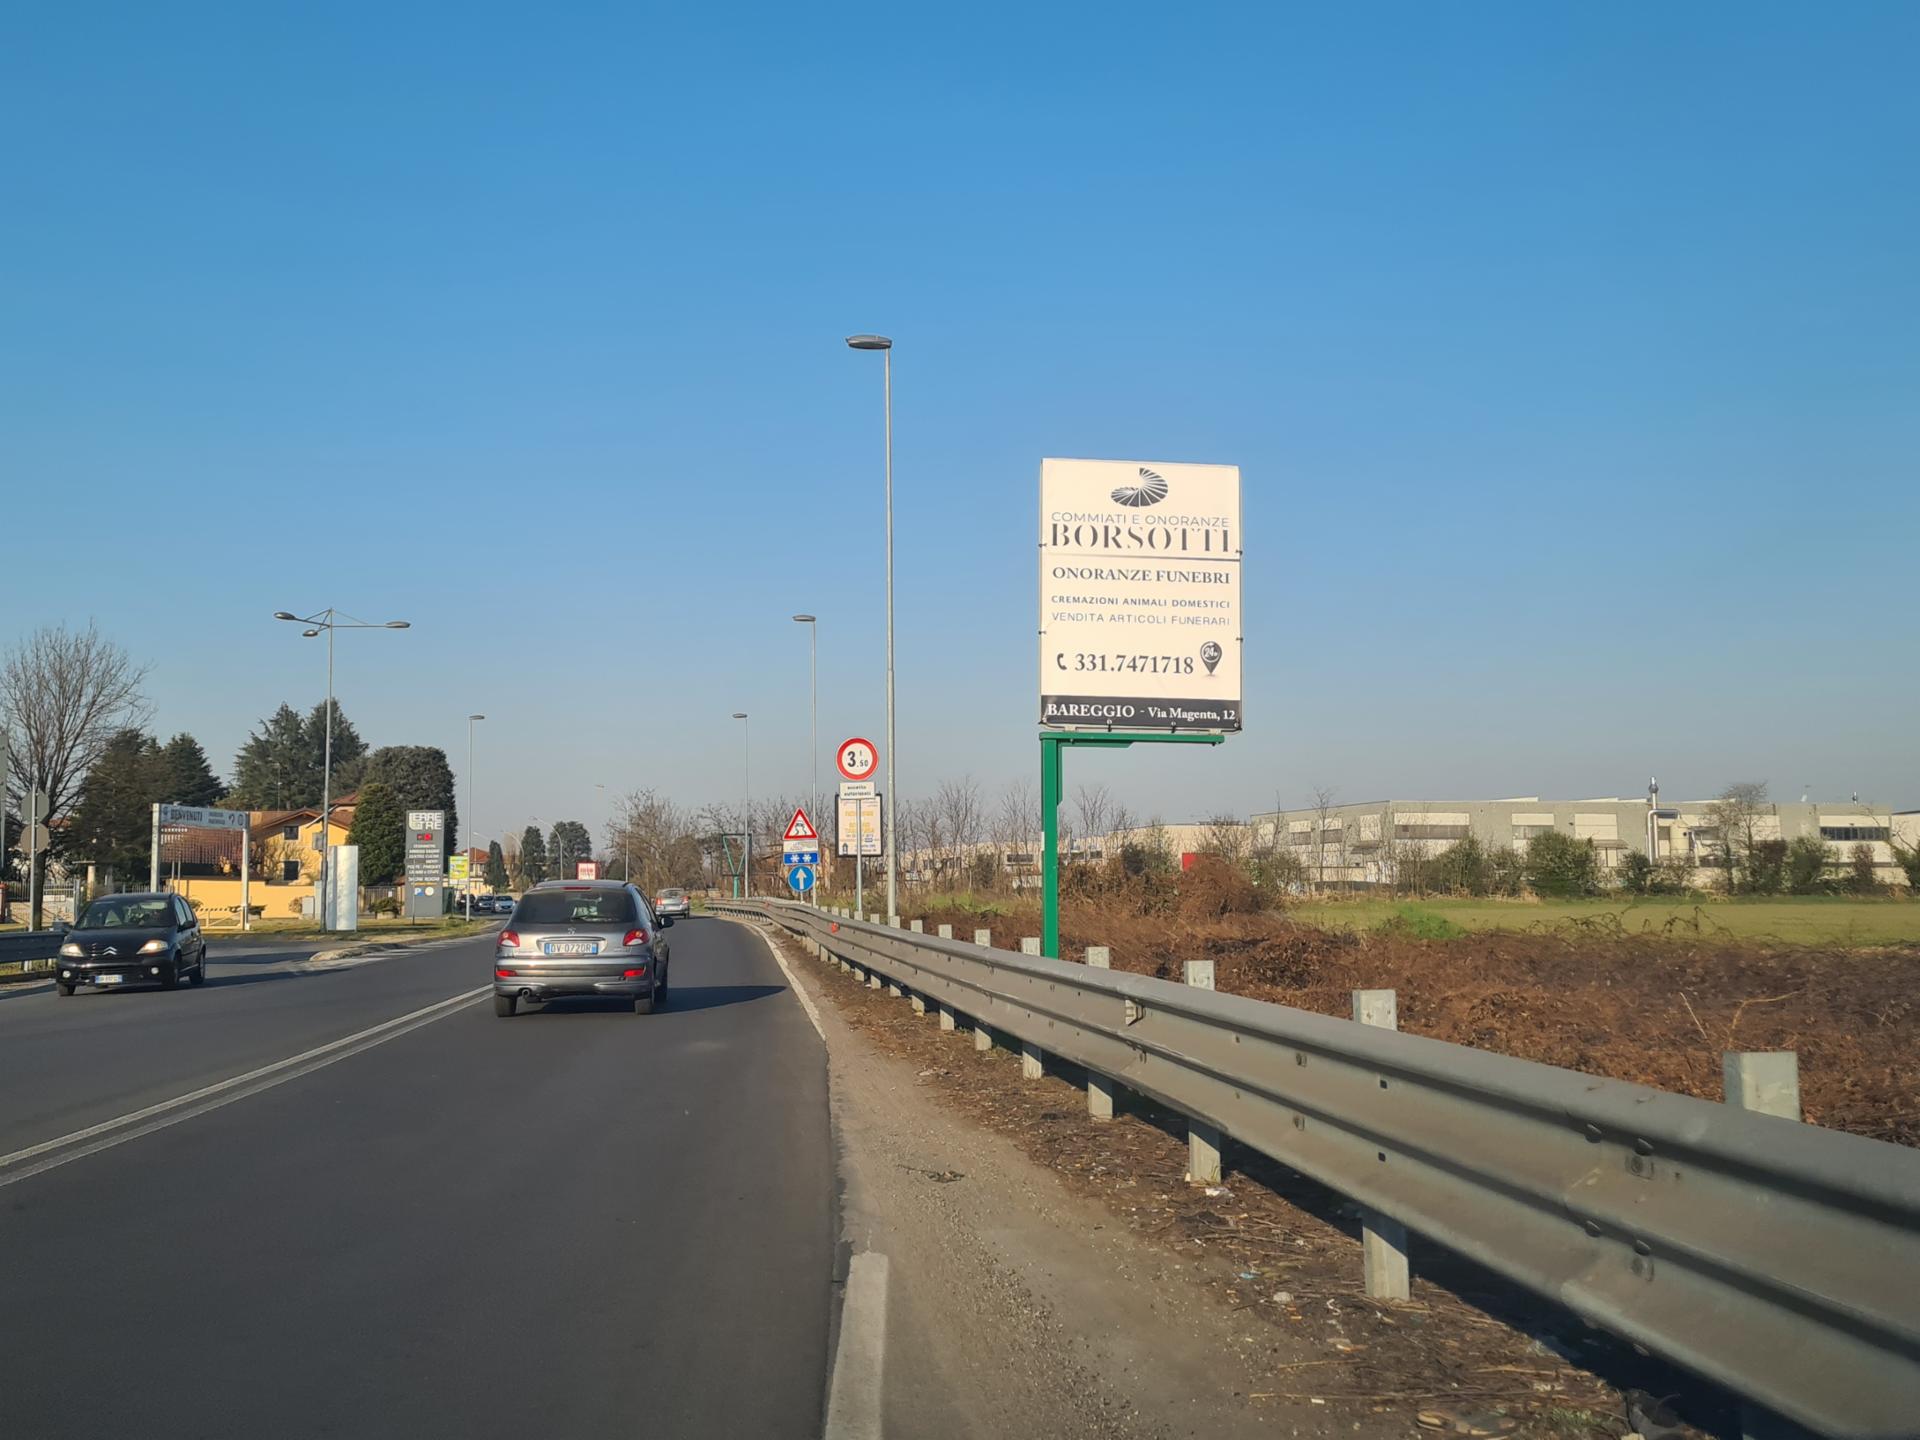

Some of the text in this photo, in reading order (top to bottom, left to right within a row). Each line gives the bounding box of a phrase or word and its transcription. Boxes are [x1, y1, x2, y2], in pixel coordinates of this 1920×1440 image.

[1051, 512, 1229, 527] COMMIATI E ONORANZE
[1052, 523, 1228, 552] BORSOTTI
[1053, 567, 1230, 584] ONORANZE FUNEBRI
[1051, 595, 1230, 609] CREMAZIONI ANIMALI DOMESTICI
[1052, 612, 1230, 626] VENDITA ARTICOLI FUNERARI
[1074, 653, 1194, 674] 331.7471718
[1047, 704, 1135, 718] BAREGGIO
[1148, 707, 1168, 719] Via
[1170, 708, 1220, 721] Magenta,
[1224, 710, 1236, 720] 12
